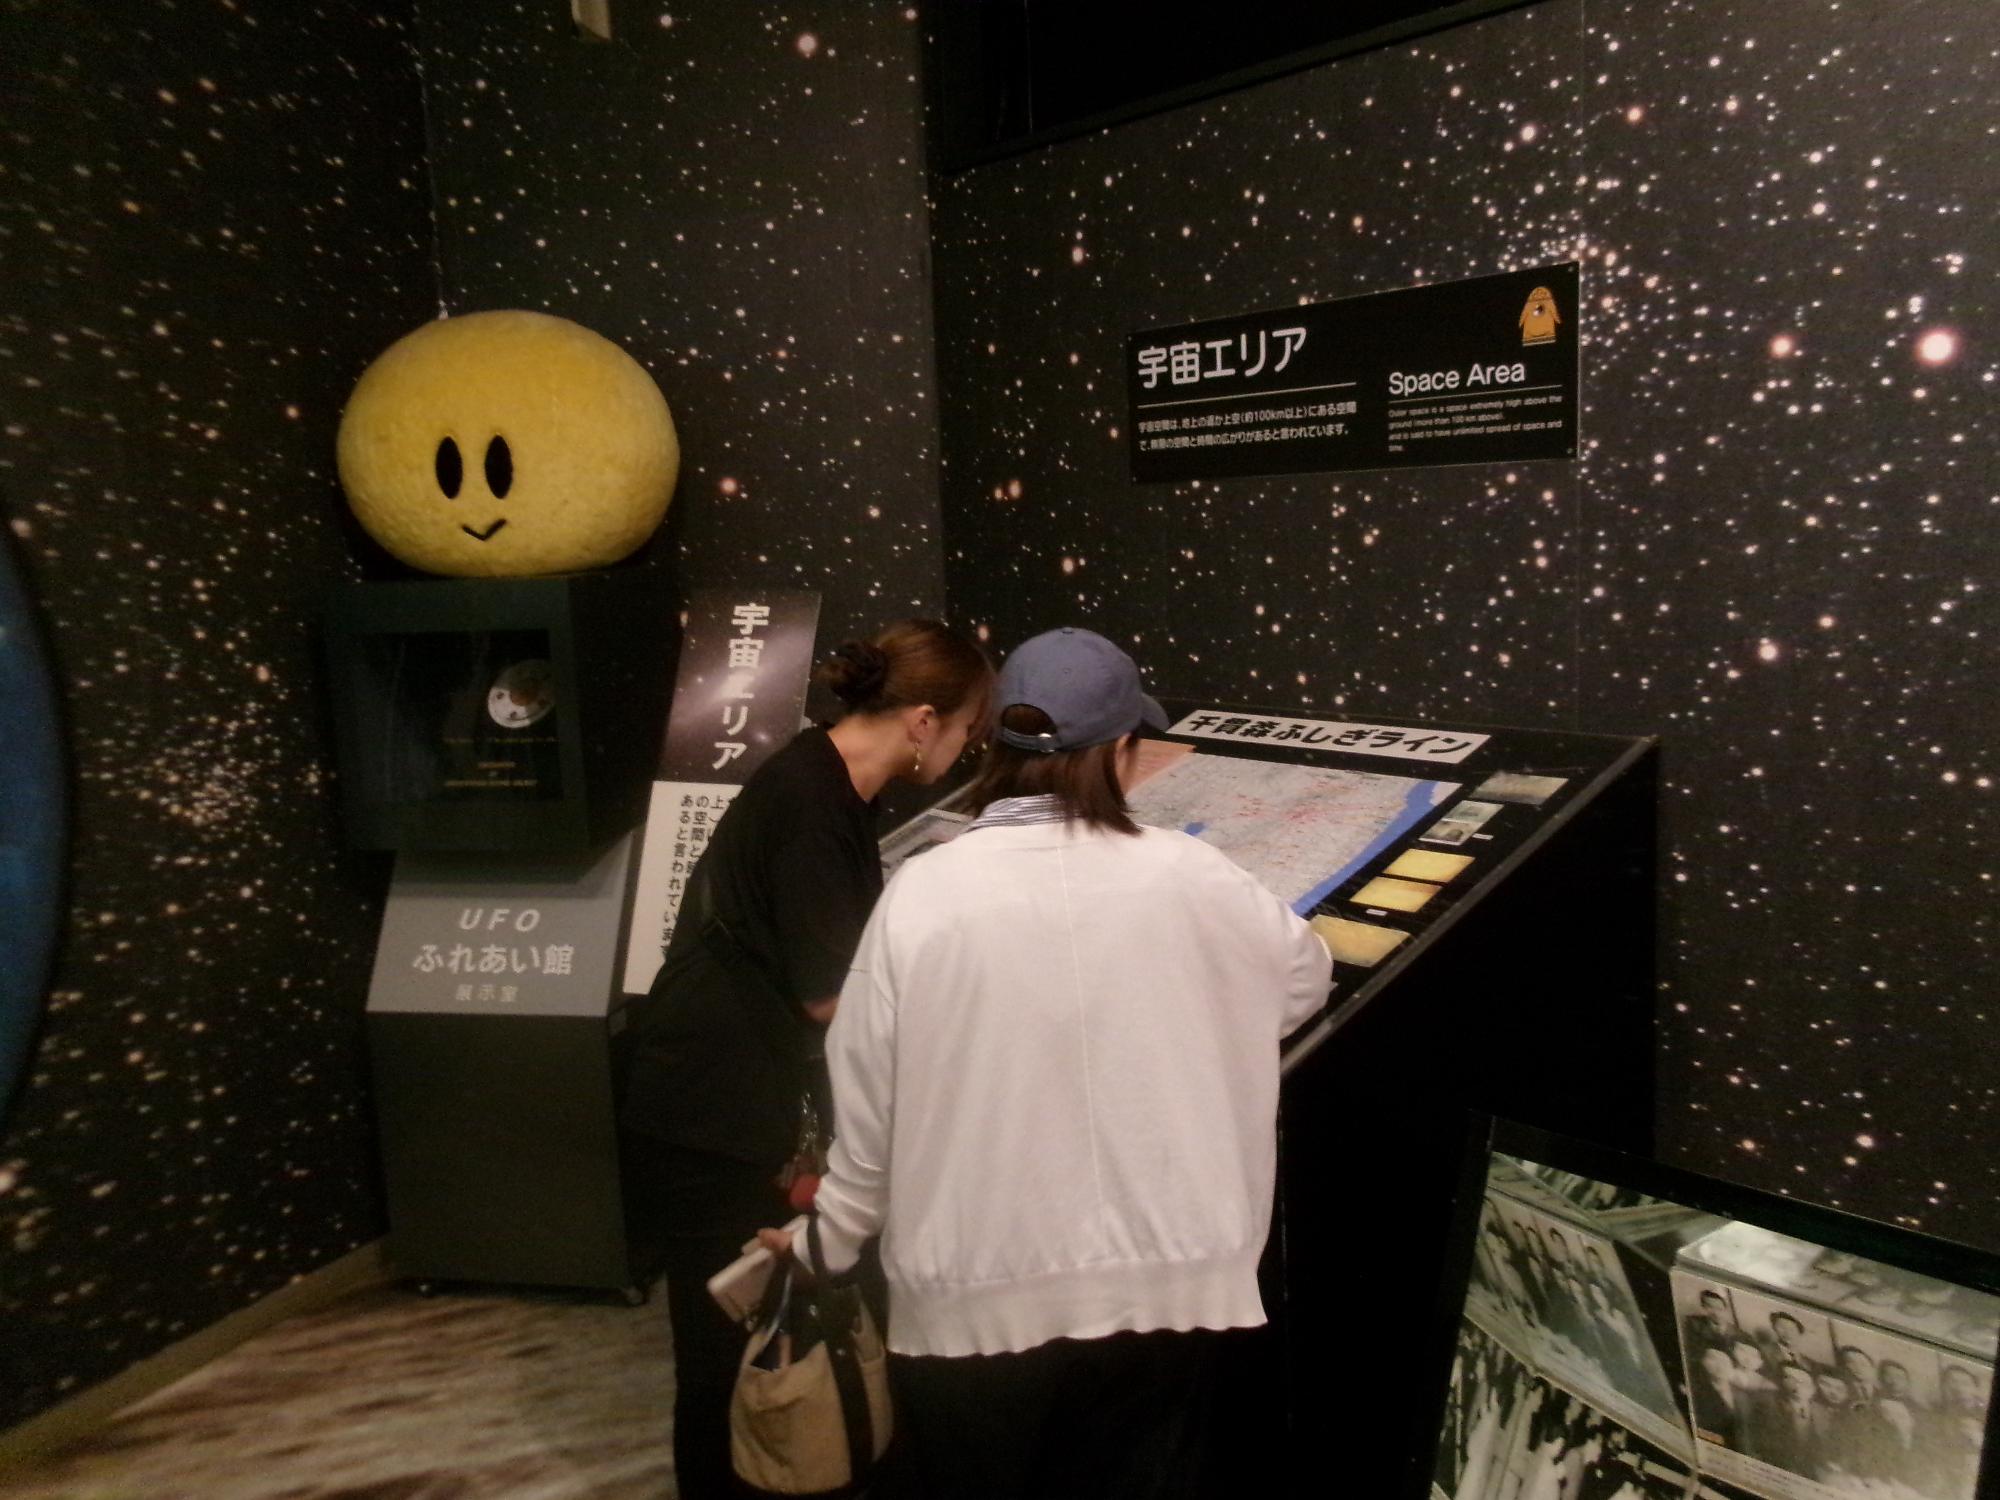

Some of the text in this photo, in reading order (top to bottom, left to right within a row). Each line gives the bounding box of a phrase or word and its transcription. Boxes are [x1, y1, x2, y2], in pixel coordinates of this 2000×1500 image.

[1137, 326, 1307, 390] 宇宙エリア
[1388, 362, 1526, 396] Space Area
[711, 602, 771, 771] 宇宙エリア
[1187, 714, 1473, 755] 千貫森ふしぎライン
[458, 908, 541, 932] UFO
[412, 943, 575, 975] ふれあい館
